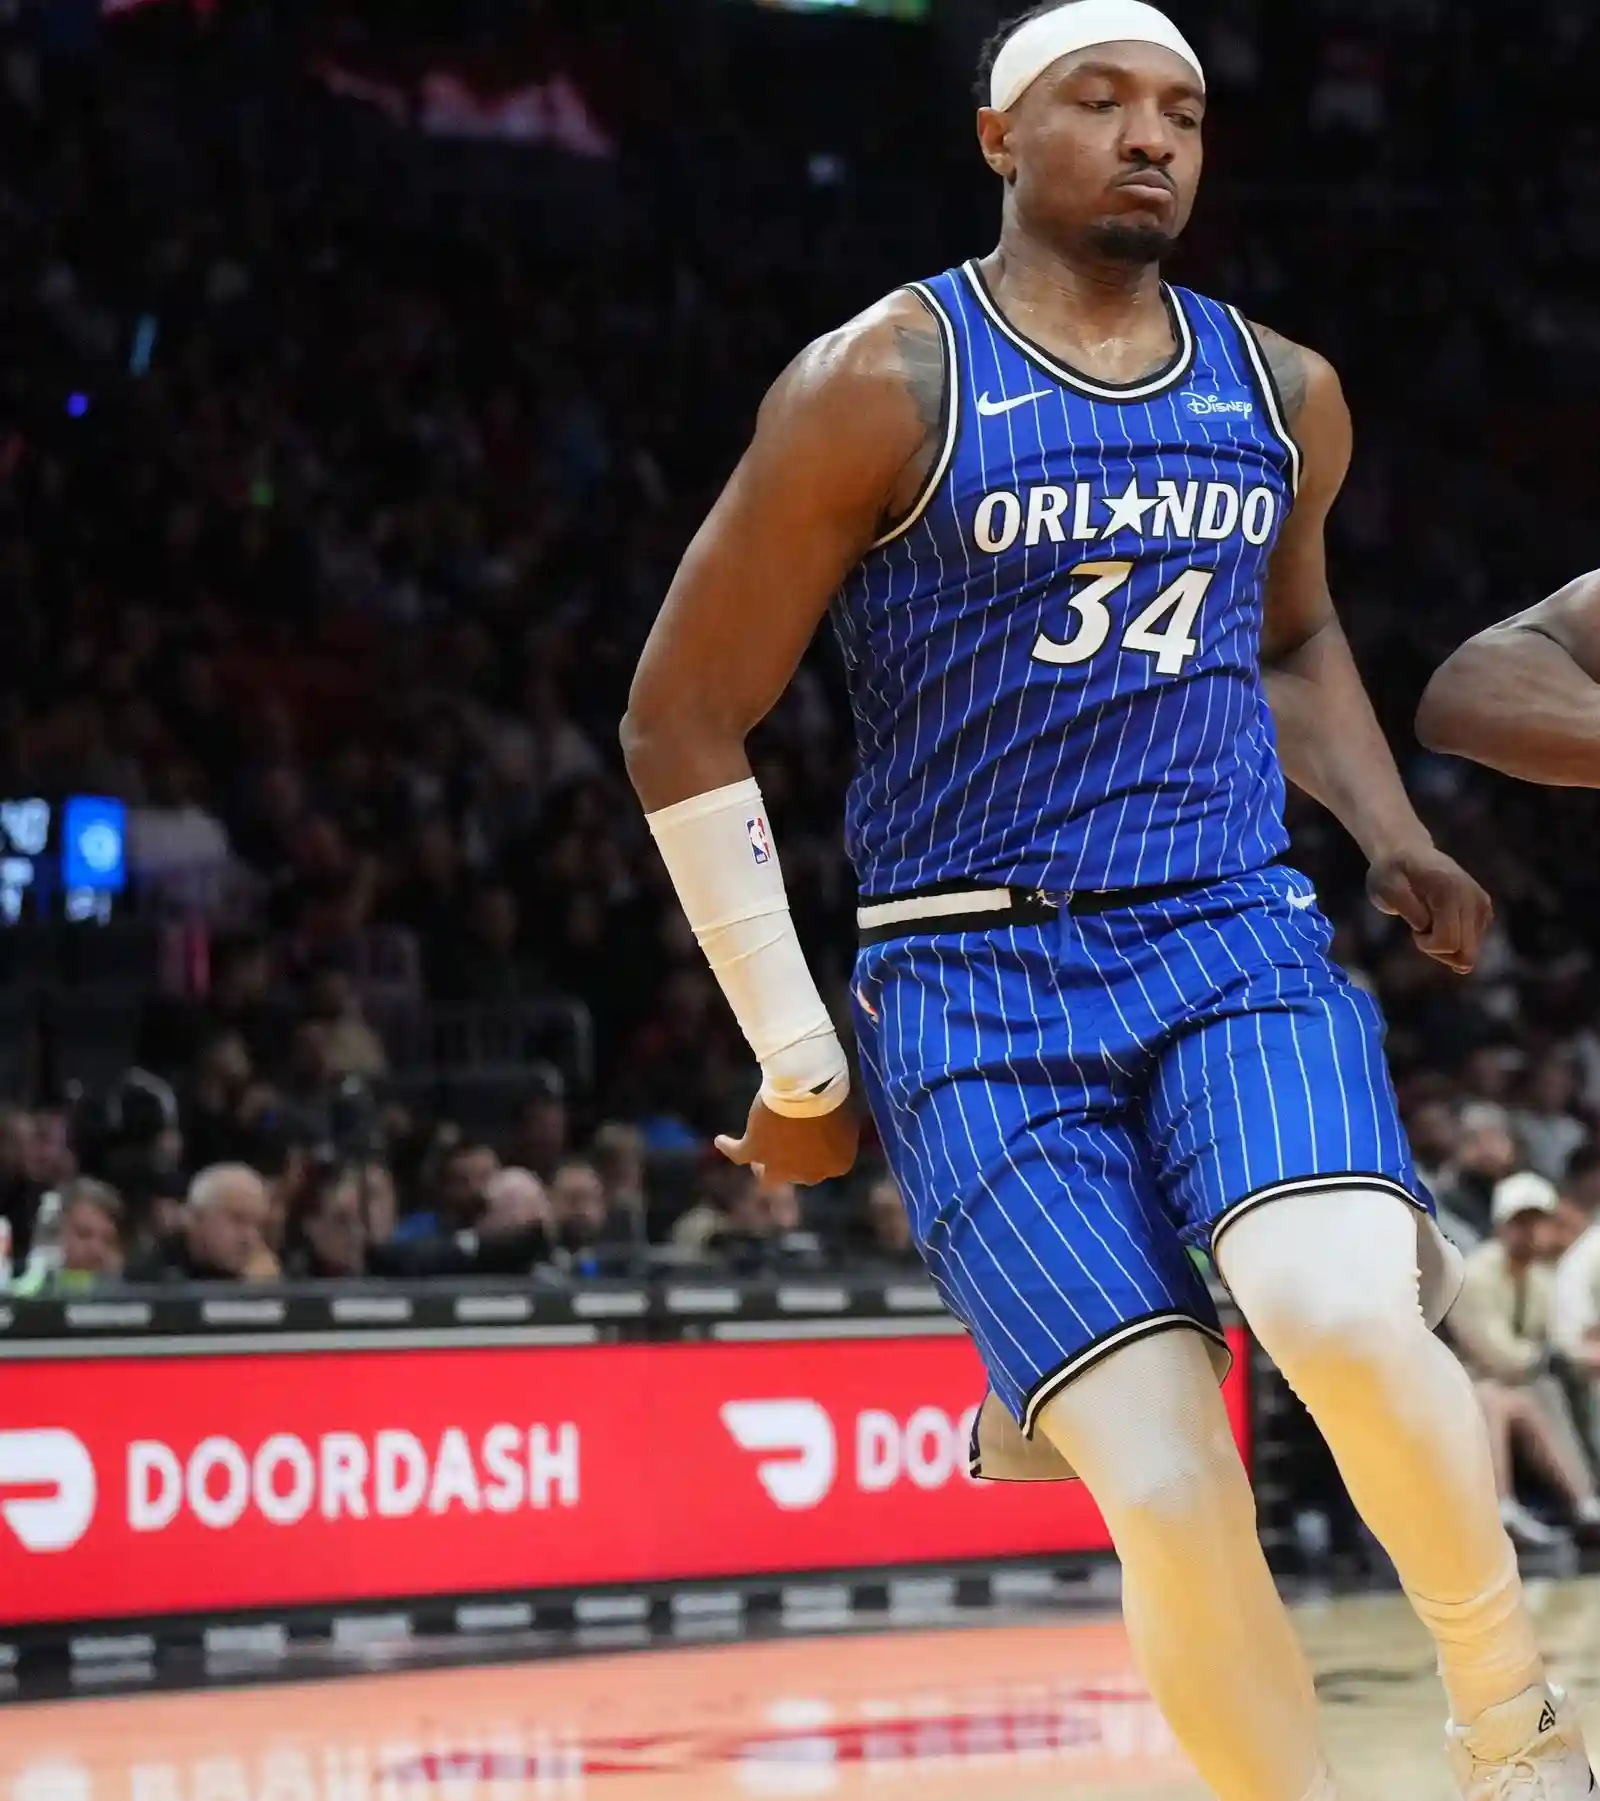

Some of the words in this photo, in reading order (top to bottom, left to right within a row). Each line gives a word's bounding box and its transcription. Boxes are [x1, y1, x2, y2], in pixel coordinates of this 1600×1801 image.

[1180, 392, 1253, 420] Disney
[1030, 560, 1217, 676] 34
[126, 1421, 581, 1531] DOORDASH
